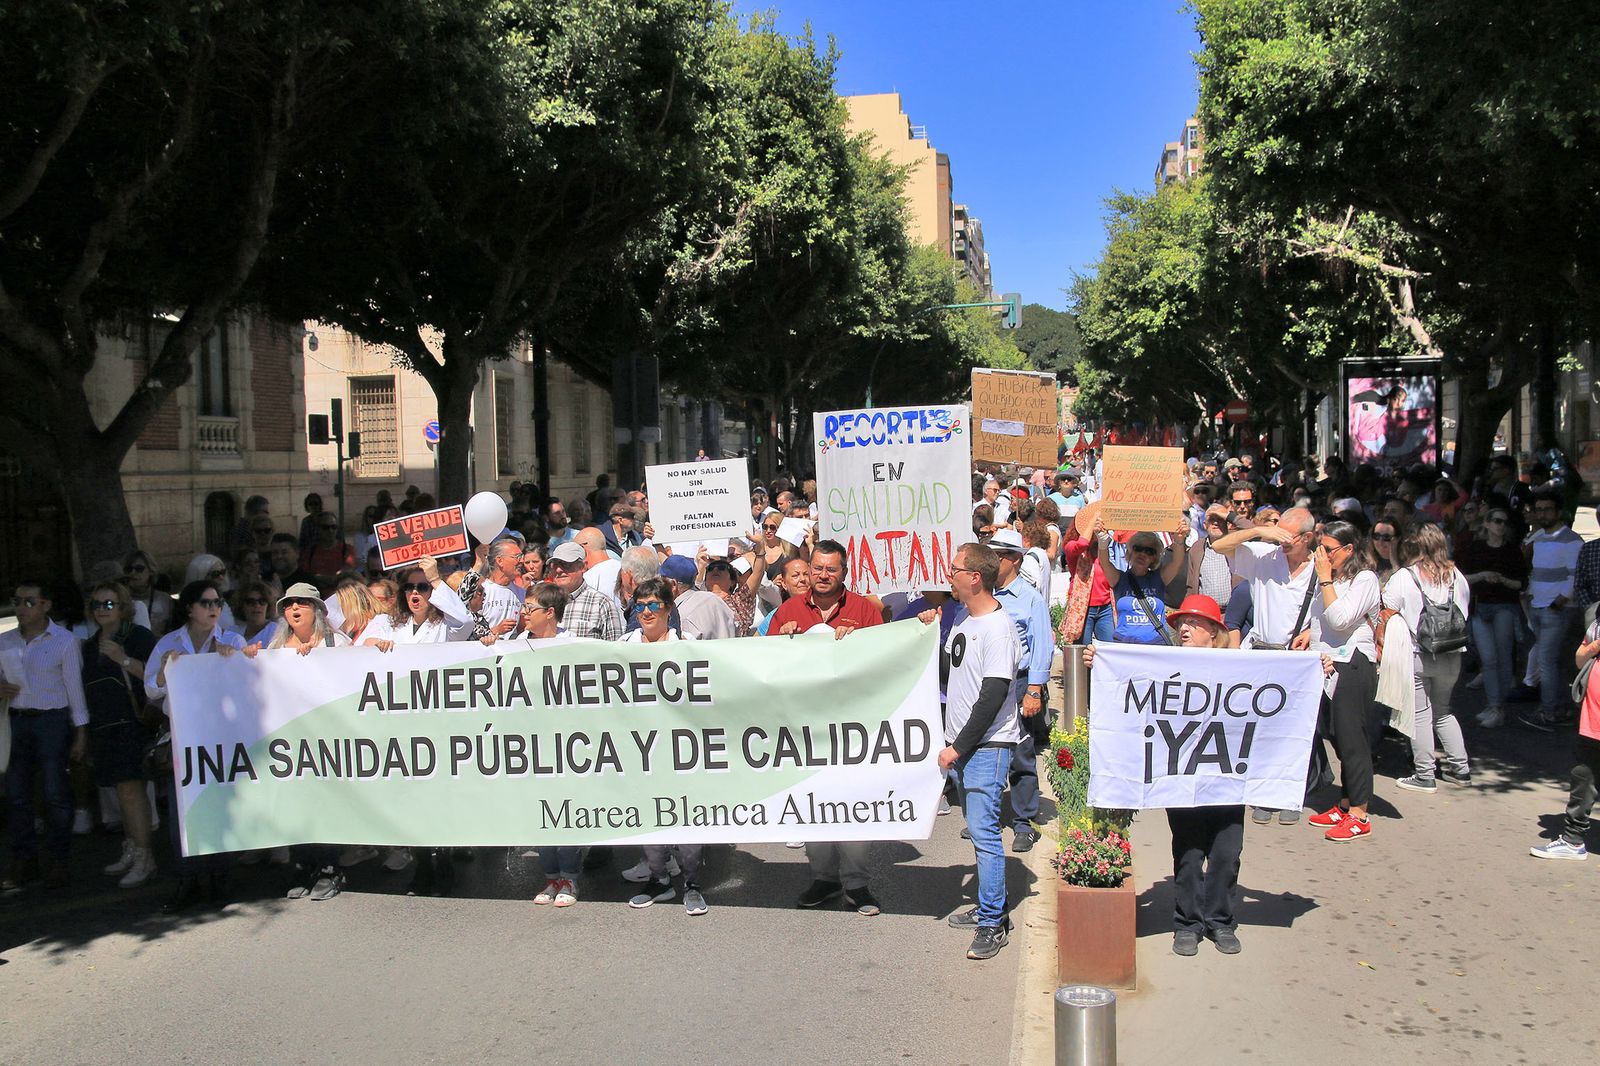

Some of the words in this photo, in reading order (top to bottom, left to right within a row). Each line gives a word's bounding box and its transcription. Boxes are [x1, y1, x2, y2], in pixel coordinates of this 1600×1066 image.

[824, 409, 952, 449] RECORTES
[681, 469, 697, 477] HAY
[700, 466, 727, 475] SALUD
[872, 461, 905, 482] EN
[696, 488, 729, 497] MENTAL
[828, 482, 952, 532] SANIDAD
[1105, 489, 1125, 502] NO
[377, 523, 399, 541] SE
[399, 508, 462, 535] VENDE
[670, 520, 737, 531] PROFESIONALES
[683, 512, 714, 520] FALTAN
[391, 548, 410, 562] TU
[411, 537, 457, 557] SALUD
[1125, 614, 1162, 623] POWR
[358, 655, 533, 711] ALMERÍA
[542, 660, 712, 706] MERECE
[1123, 671, 1288, 718] MÉDICO
[268, 736, 437, 778] SANIDAD
[450, 723, 623, 776] PÚBLICA
[630, 729, 658, 772] Y
[671, 728, 729, 771] DE
[741, 718, 931, 769] CALIDAD
[1143, 719, 1257, 784] ¡YA!
[538, 799, 643, 829] Marea
[651, 795, 769, 828] Blanca
[777, 790, 918, 825] Almería
